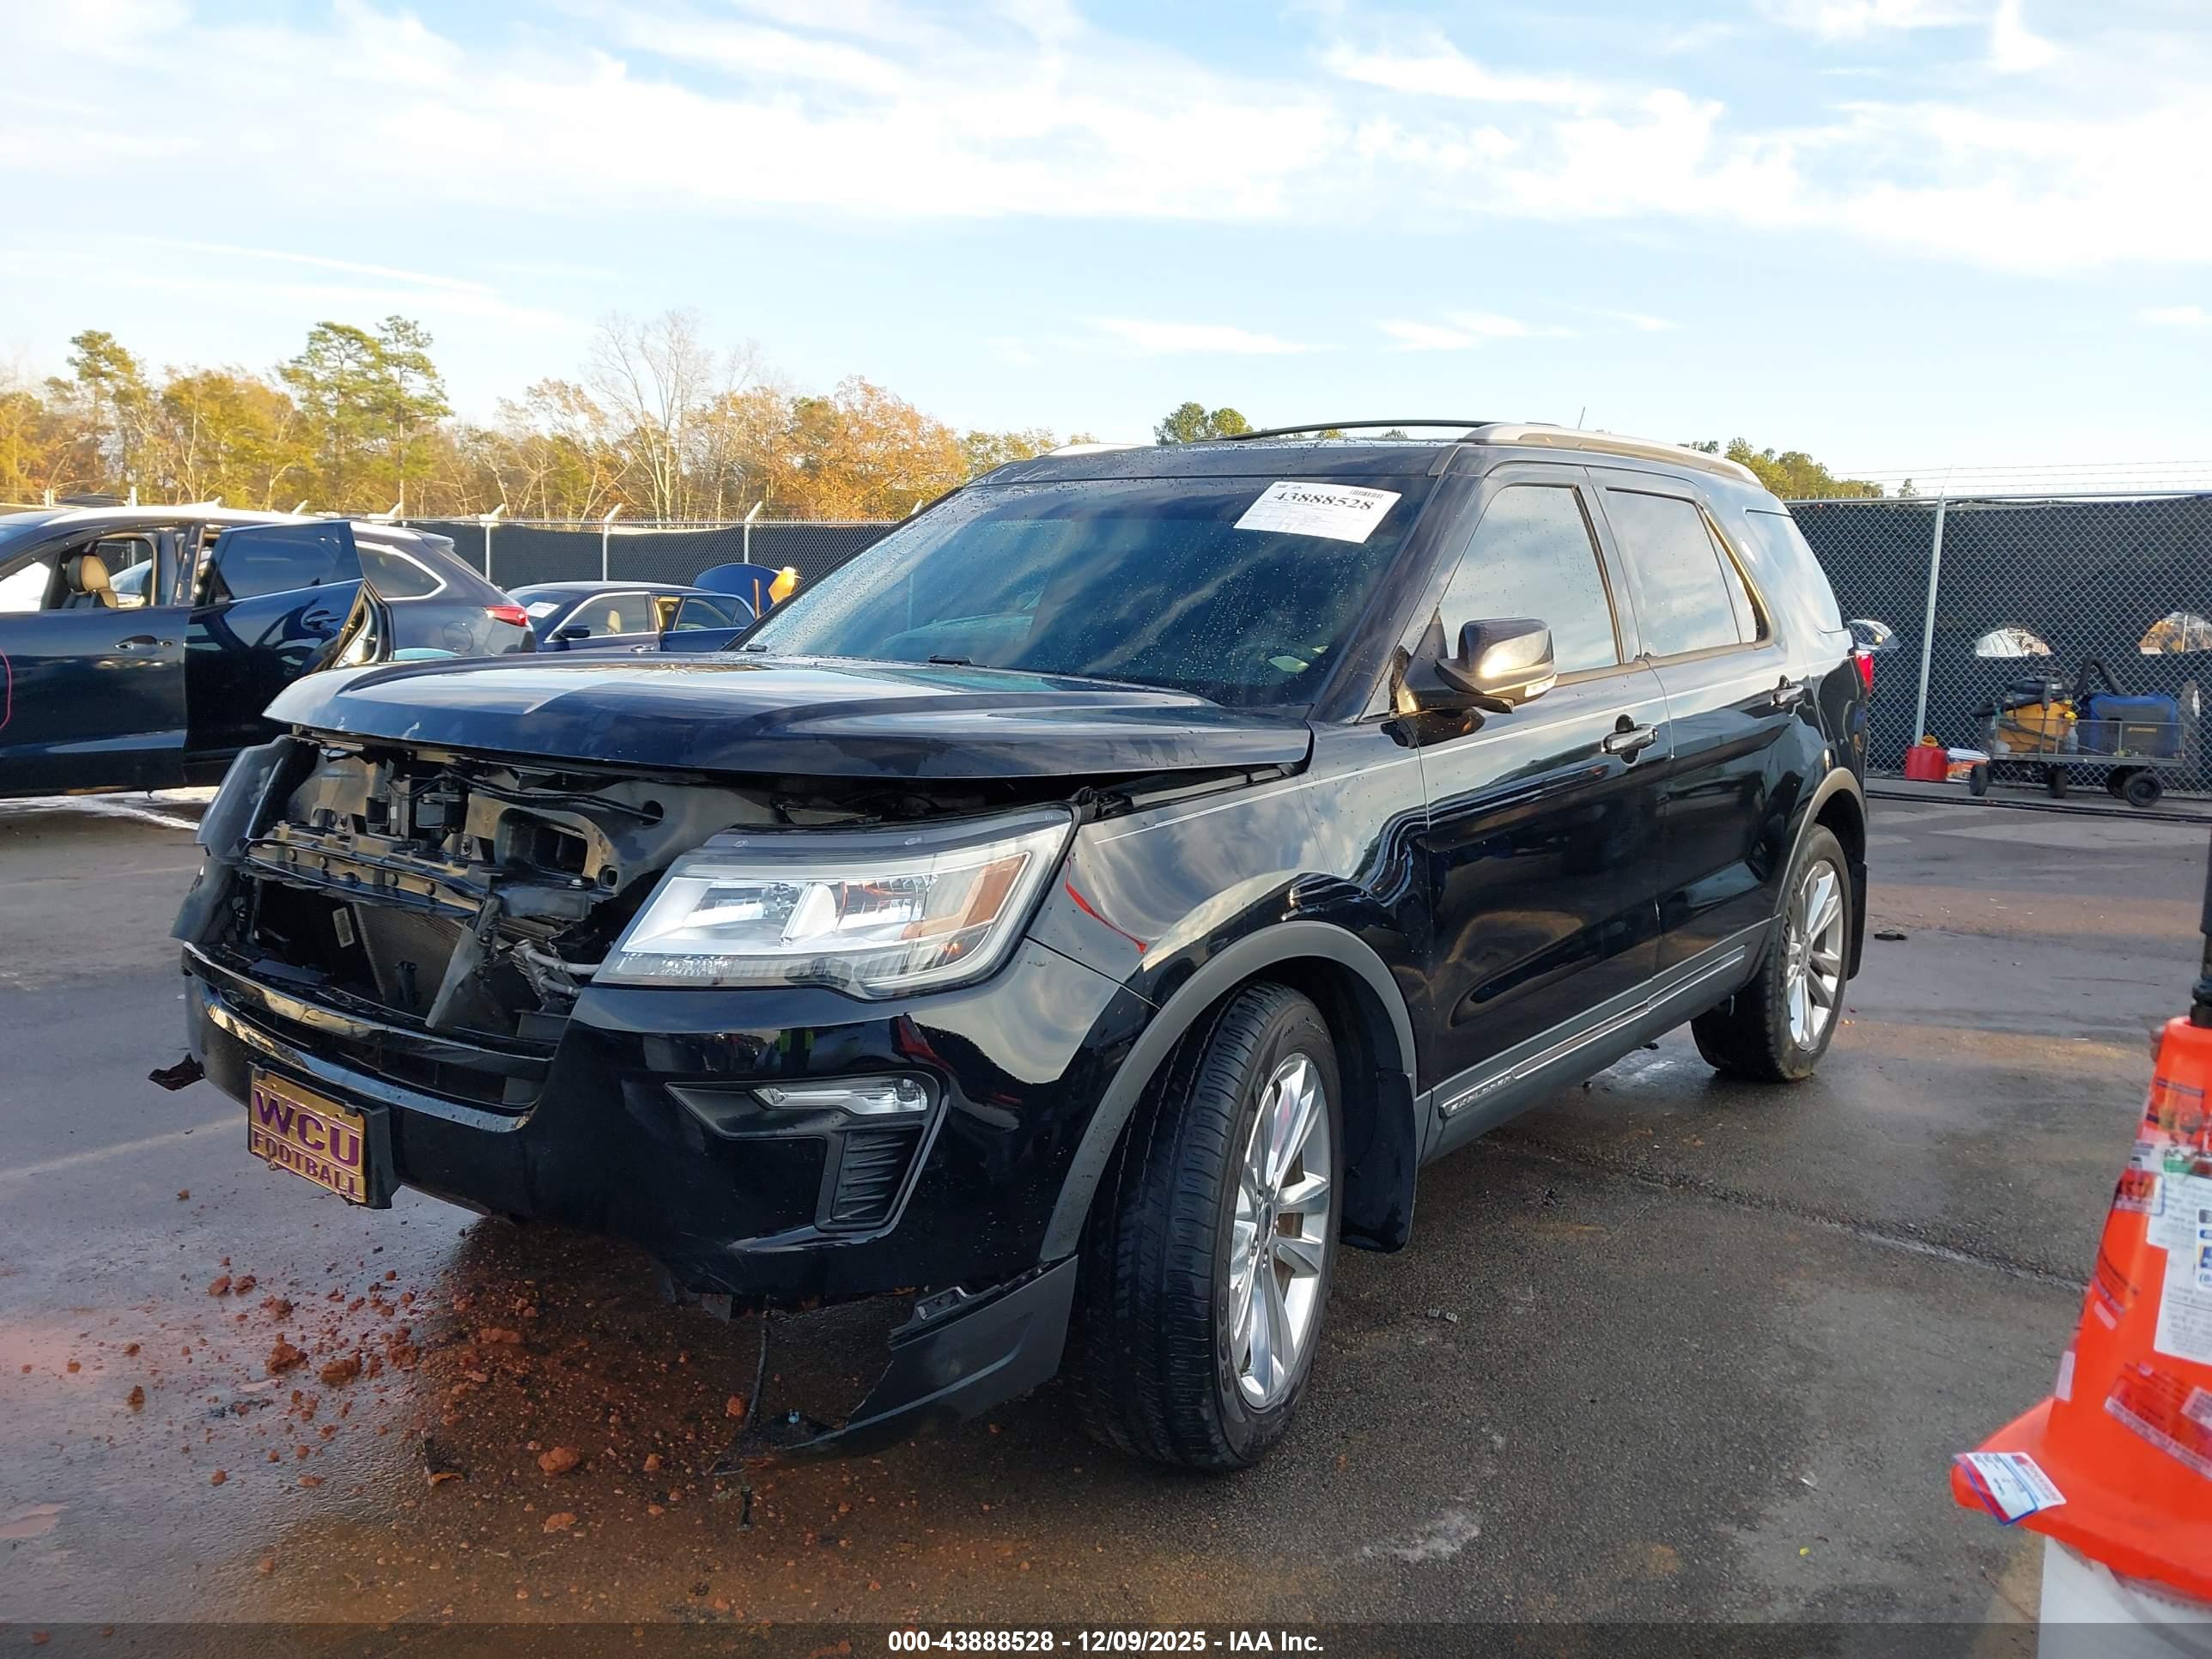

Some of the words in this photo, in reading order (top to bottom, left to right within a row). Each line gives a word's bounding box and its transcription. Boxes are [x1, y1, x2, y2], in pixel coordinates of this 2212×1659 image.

[1273, 491, 1376, 511] 43888528
[253, 1088, 362, 1167] WCU
[253, 1128, 362, 1197] FOOTBALL
